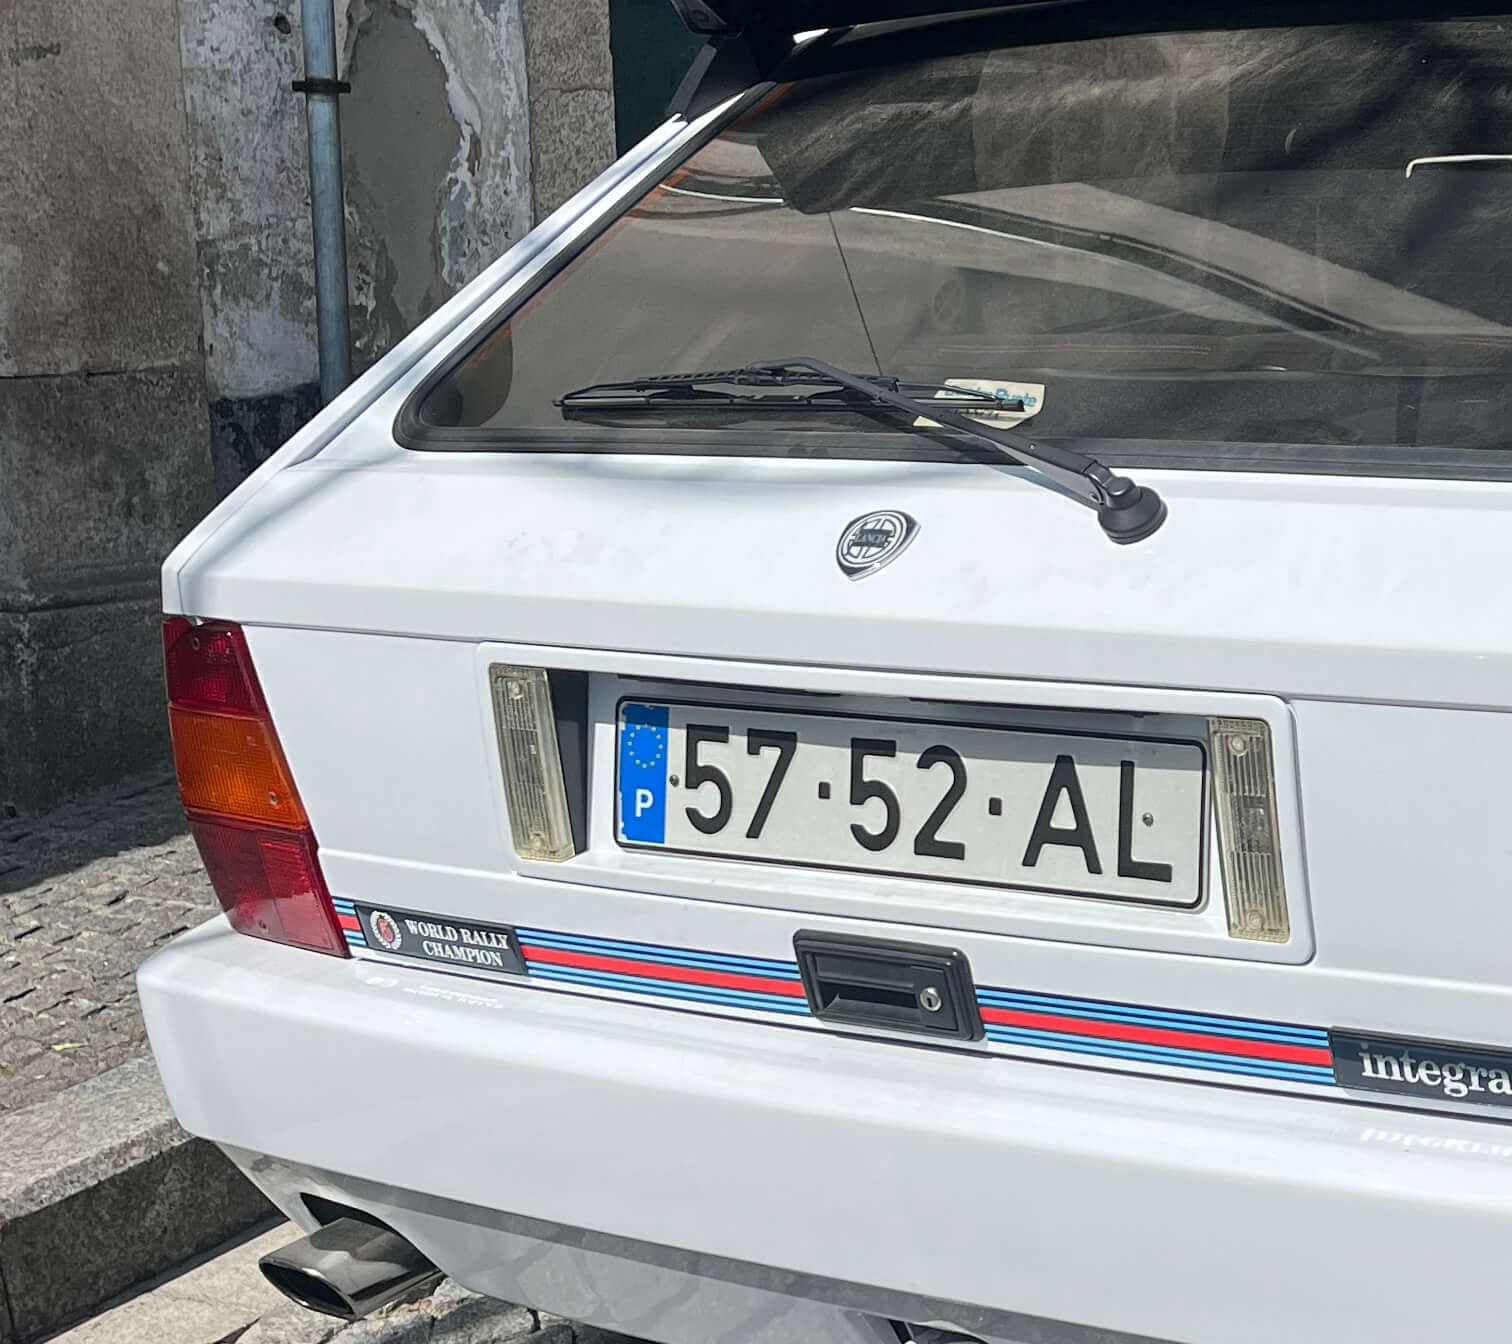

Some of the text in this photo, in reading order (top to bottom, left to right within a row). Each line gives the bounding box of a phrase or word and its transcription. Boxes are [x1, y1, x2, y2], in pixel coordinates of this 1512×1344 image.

[634, 788, 653, 818] P
[404, 919, 510, 949] WORLD RALLY
[423, 940, 503, 967] CHAMPION
